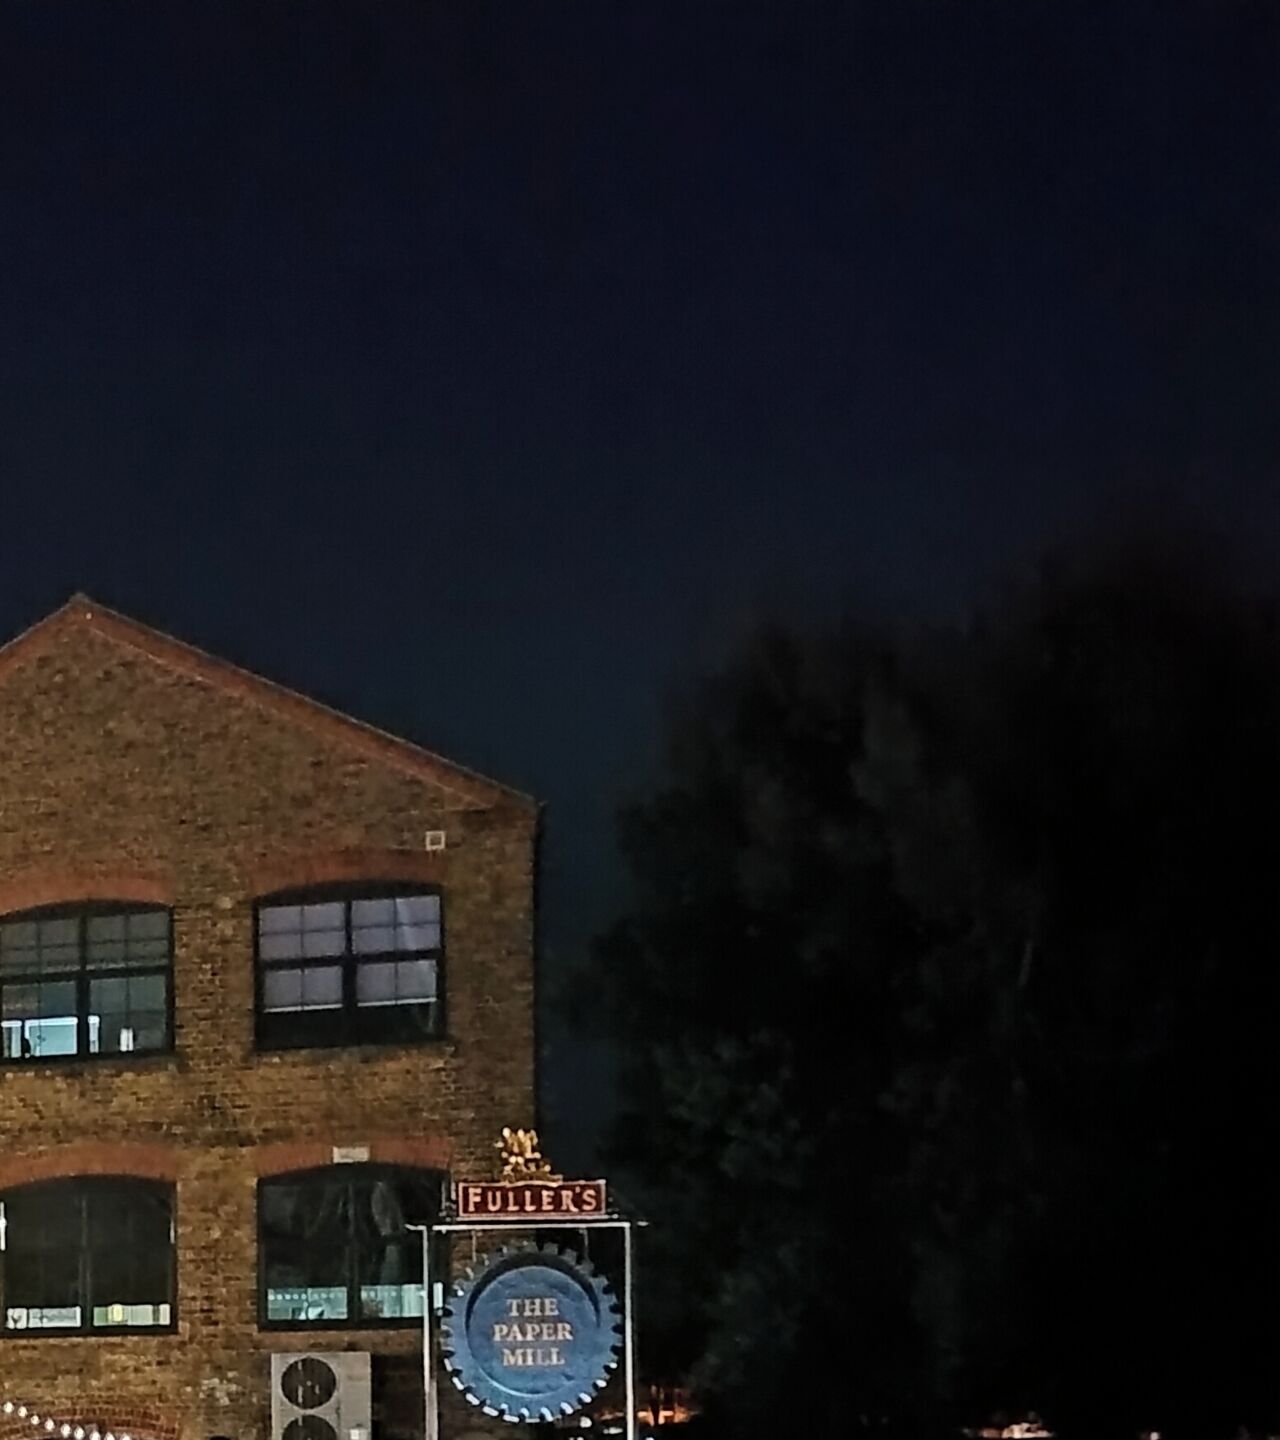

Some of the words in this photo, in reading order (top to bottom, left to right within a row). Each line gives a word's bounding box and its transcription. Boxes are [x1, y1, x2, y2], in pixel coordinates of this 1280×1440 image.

[468, 1185, 598, 1212] FULLER'S
[506, 1298, 560, 1317] THE
[493, 1323, 574, 1341] PAPER
[502, 1348, 566, 1367] MILL
